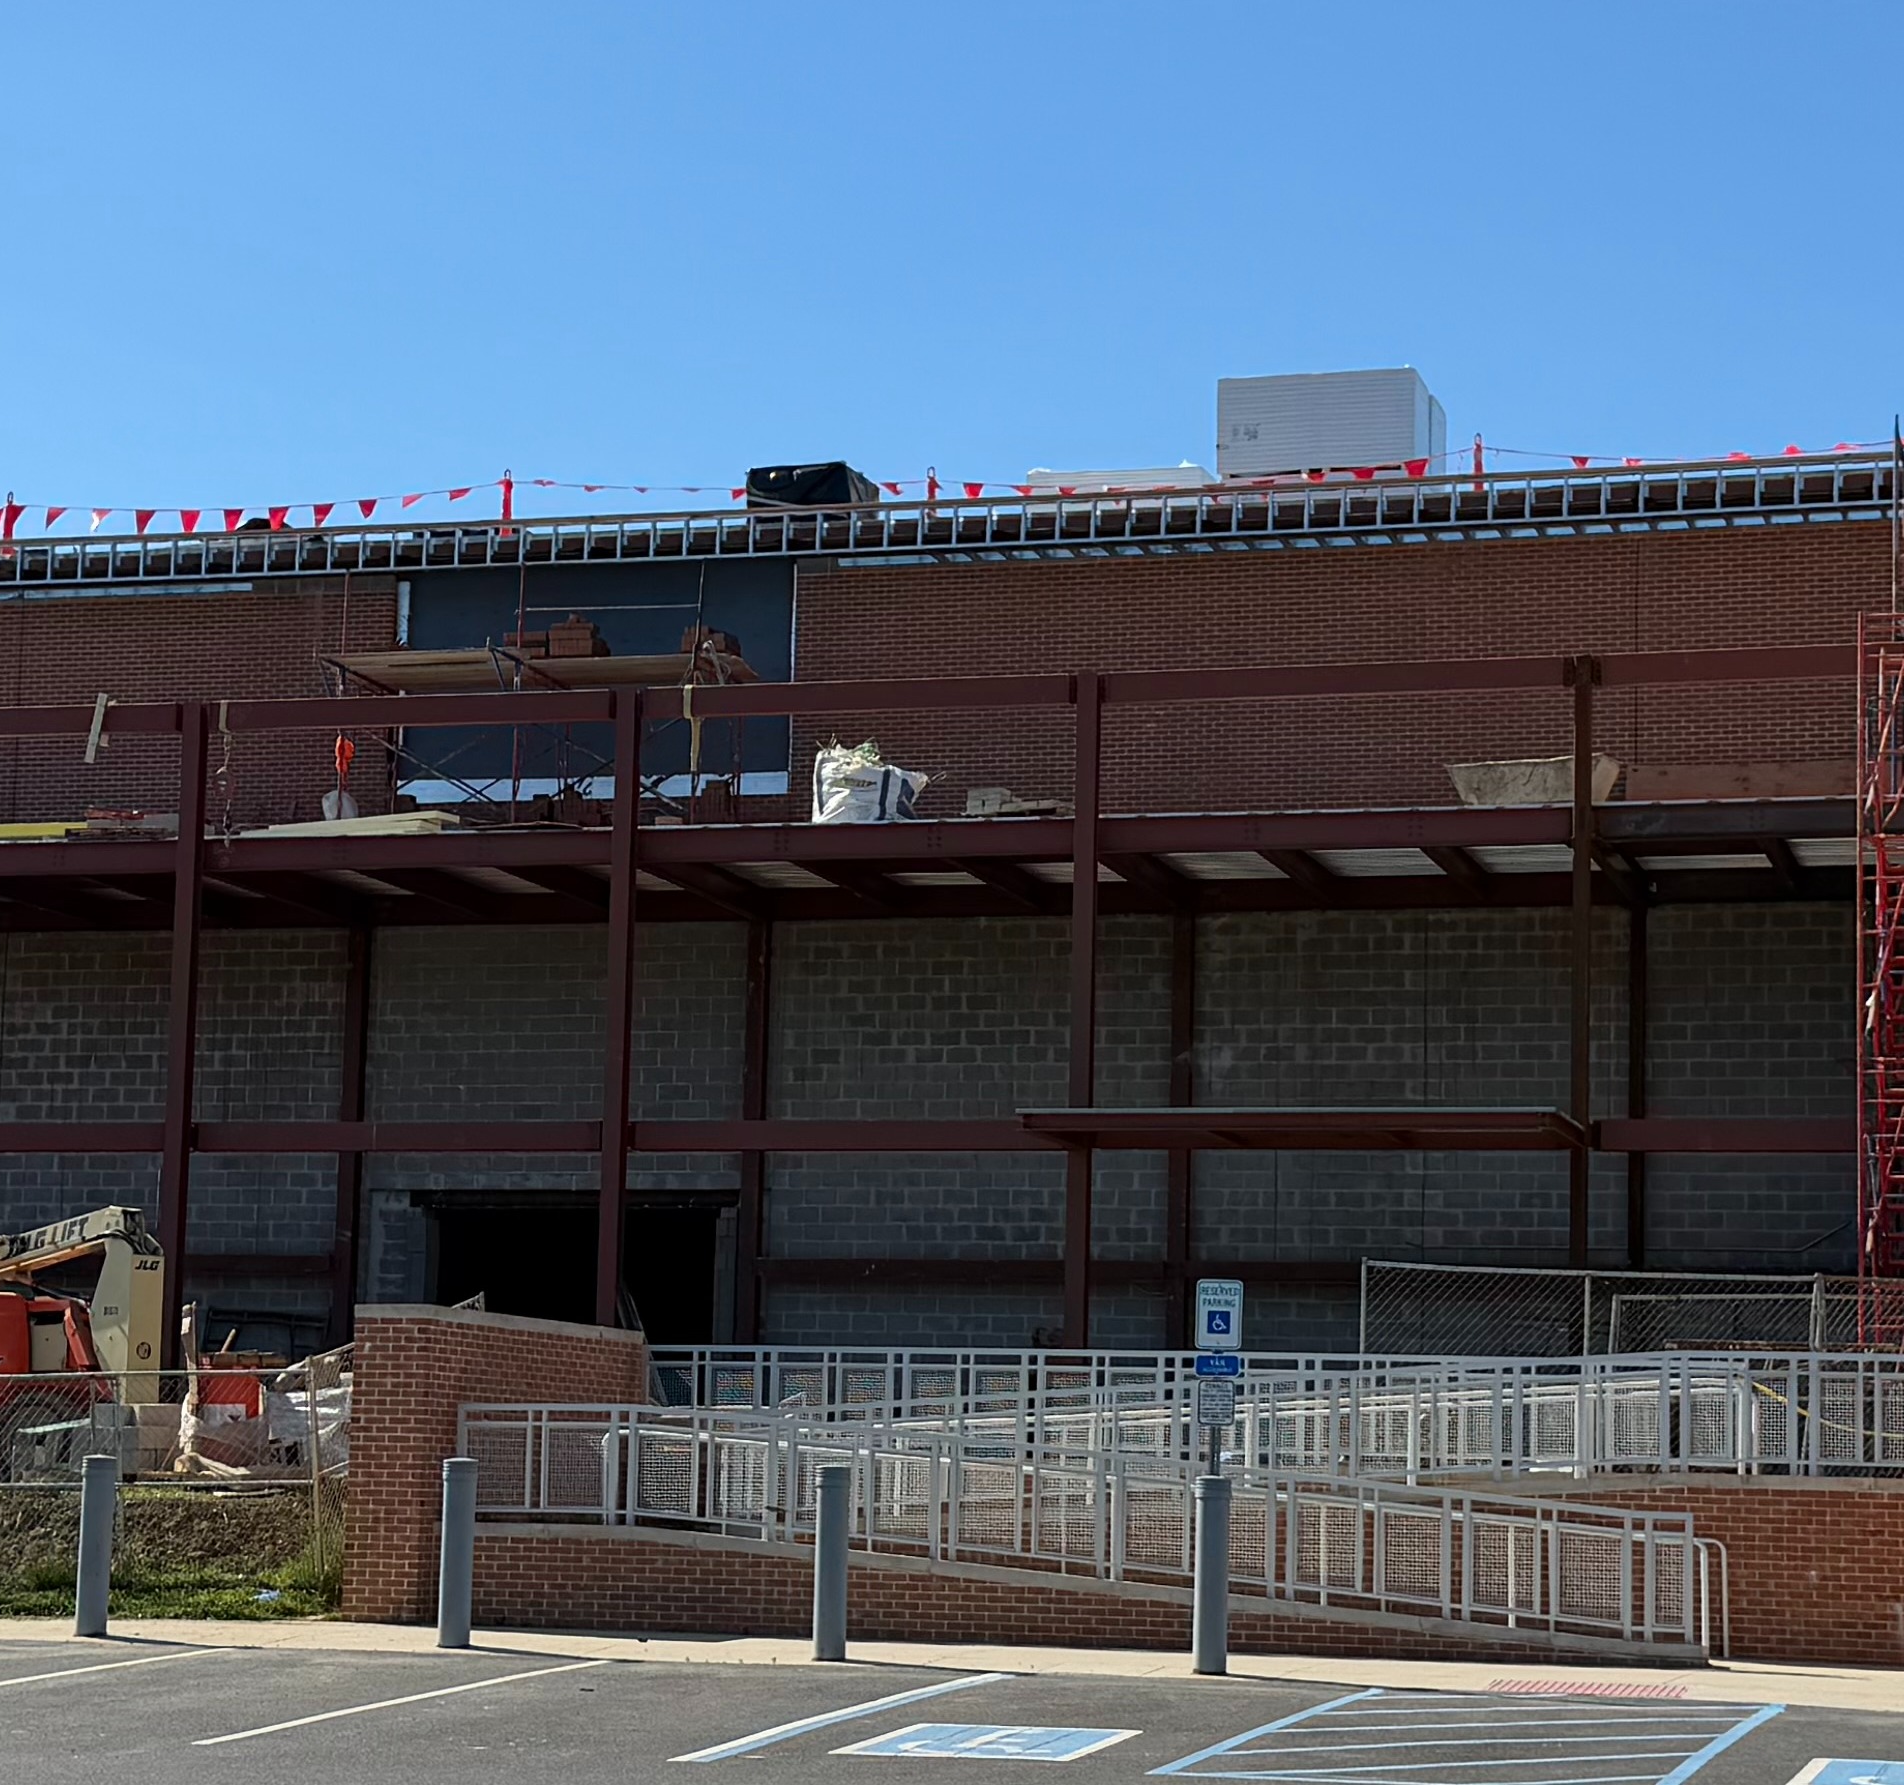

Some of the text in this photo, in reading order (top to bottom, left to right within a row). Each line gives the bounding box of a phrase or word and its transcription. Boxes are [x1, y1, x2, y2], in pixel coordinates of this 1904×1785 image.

[50, 1216, 89, 1246] LIFT
[134, 1259, 161, 1271] JLG
[1202, 1297, 1237, 1308] PARKING
